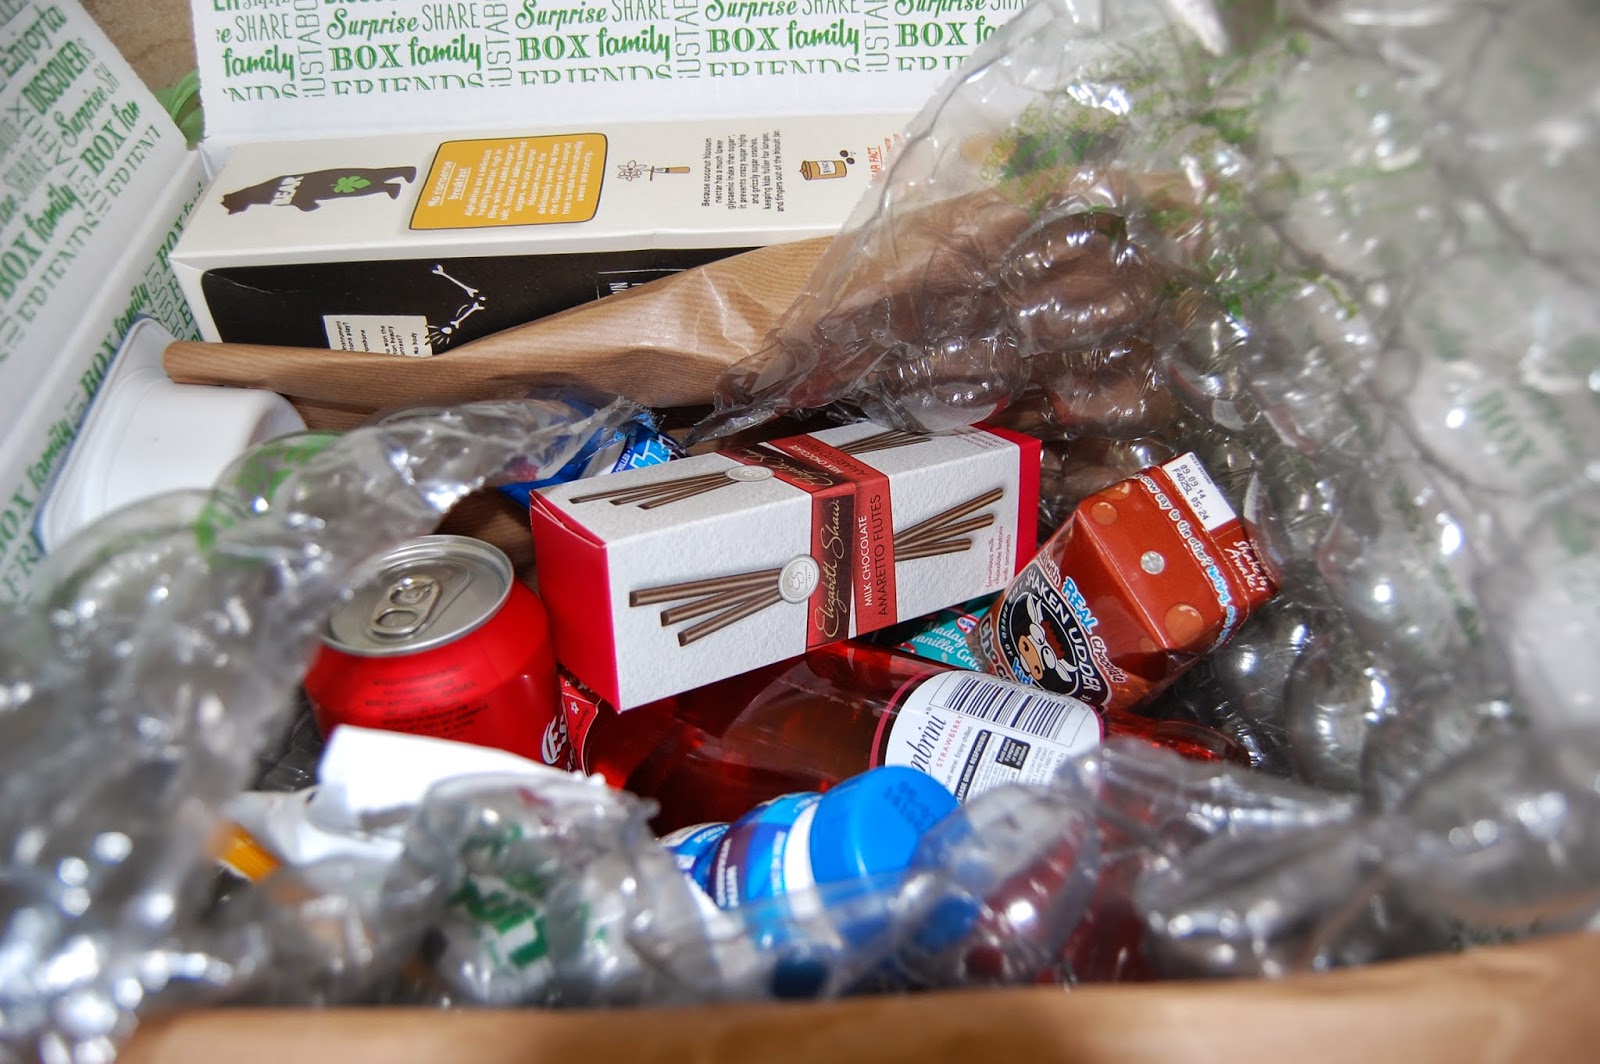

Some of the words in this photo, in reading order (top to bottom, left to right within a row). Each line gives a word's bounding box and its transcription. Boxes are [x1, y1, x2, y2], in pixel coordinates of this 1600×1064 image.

[326, 8, 419, 41] Surprise
[422, 3, 480, 32] SHARE
[514, 0, 608, 31] Surprise
[612, 0, 670, 22] SHARE
[705, 0, 799, 24] Surprise
[235, 13, 293, 43] SHARE
[706, 26, 780, 53] BOX
[786, 18, 860, 56] family
[894, 22, 968, 48] BOX
[975, 15, 1004, 45] fa
[328, 44, 403, 71] BOX
[408, 33, 481, 71] family
[515, 34, 591, 61] BOX
[596, 25, 671, 62] family
[222, 44, 295, 81] family
[22, 41, 91, 115] DISCOVER
[54, 86, 108, 147] Surprise
[80, 119, 127, 178] BOX
[703, 137, 711, 158] blossom
[714, 139, 722, 153] lower
[738, 134, 747, 147] highs
[772, 138, 780, 154] biscuit
[726, 152, 734, 164] than
[739, 163, 748, 177] crazy
[751, 158, 759, 172] sugar
[761, 159, 770, 173] fuller
[431, 160, 453, 194] nonsense
[447, 167, 468, 199] breakfast
[714, 174, 722, 183] has
[726, 166, 734, 180] index
[750, 174, 760, 192] grizzly
[761, 175, 770, 186] kids
[774, 171, 782, 180] out
[427, 195, 442, 206] No
[701, 183, 710, 206] Because
[726, 181, 735, 209] glycaemic
[739, 178, 747, 202] prevents
[750, 194, 758, 203] and
[762, 187, 772, 209] keeping
[774, 181, 784, 200] fingers
[24, 182, 85, 244] family
[775, 201, 784, 211] and
[342, 322, 351, 335] play?
[387, 326, 396, 343] beauty
[410, 332, 418, 344] body
[1189, 454, 1199, 467] BEST
[1198, 467, 1212, 485] BEFORE
[820, 500, 844, 563] Shaw
[869, 493, 883, 541] FLUTES
[1142, 476, 1158, 493] cow
[1157, 493, 1171, 509] say
[1170, 510, 1179, 520] to
[1179, 522, 1190, 537] the
[1190, 538, 1213, 567] other?
[858, 514, 871, 582] CHOCOLATE
[1225, 548, 1265, 592] Awake!
[1233, 541, 1260, 574] Shake
[1257, 576, 1267, 587] to
[862, 581, 872, 607] MILK
[873, 542, 887, 618] AMARETTO
[813, 556, 847, 642] Elizabeth
[1026, 568, 1071, 625] SHAKEN
[1069, 628, 1102, 692] UDDER
[1063, 578, 1097, 633] REAL
[1091, 637, 1127, 682] Chocolate
[936, 714, 964, 768] STRAWBERRY
[953, 742, 966, 759] Enjoy
[961, 725, 973, 742] chilled.
[953, 780, 968, 800] LEASE
